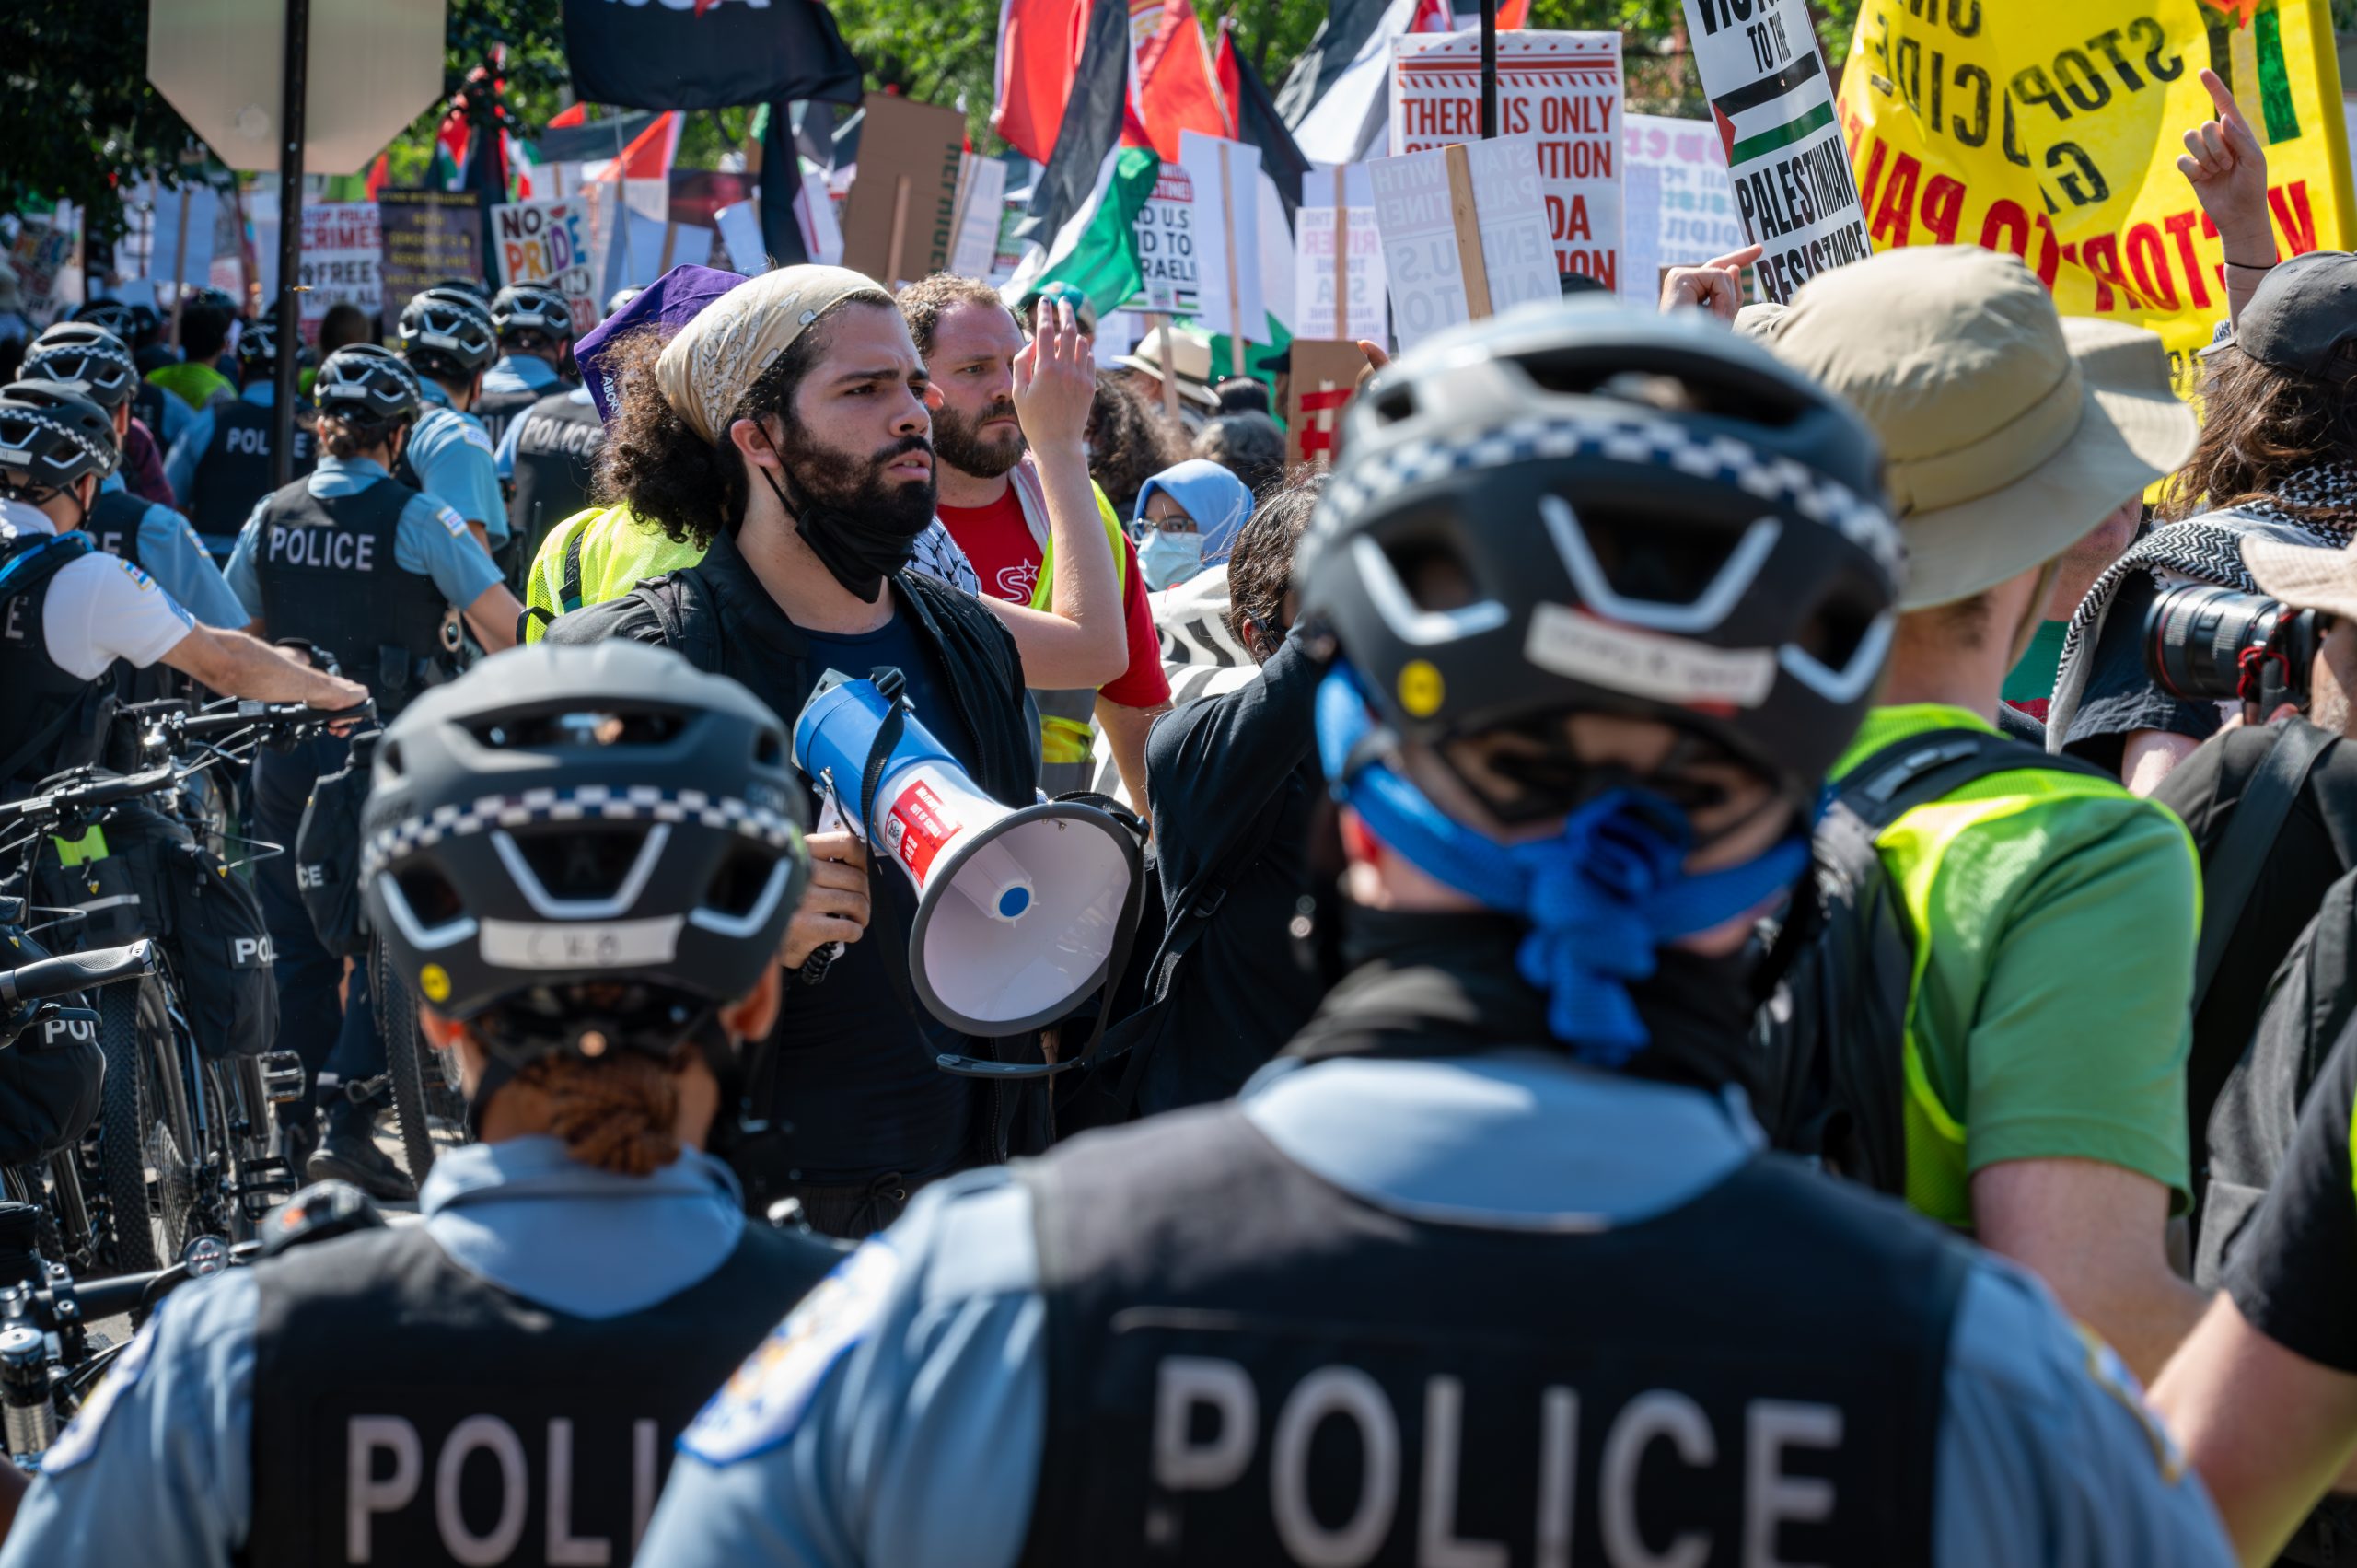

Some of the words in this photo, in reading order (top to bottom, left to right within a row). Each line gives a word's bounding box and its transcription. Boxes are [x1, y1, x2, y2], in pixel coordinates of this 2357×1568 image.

[1746, 20, 1774, 74] TO
[1768, 11, 1792, 64] THE
[1503, 97, 1530, 134] IS
[1540, 95, 1615, 134] ONLY
[1735, 135, 1855, 249] PALESTINIAN
[500, 206, 541, 239] NO
[1166, 231, 1192, 256] TO
[317, 261, 372, 285] FREE
[519, 416, 606, 456] POLICE
[268, 528, 376, 571] POLICE
[1146, 1354, 1844, 1568] POLICE
